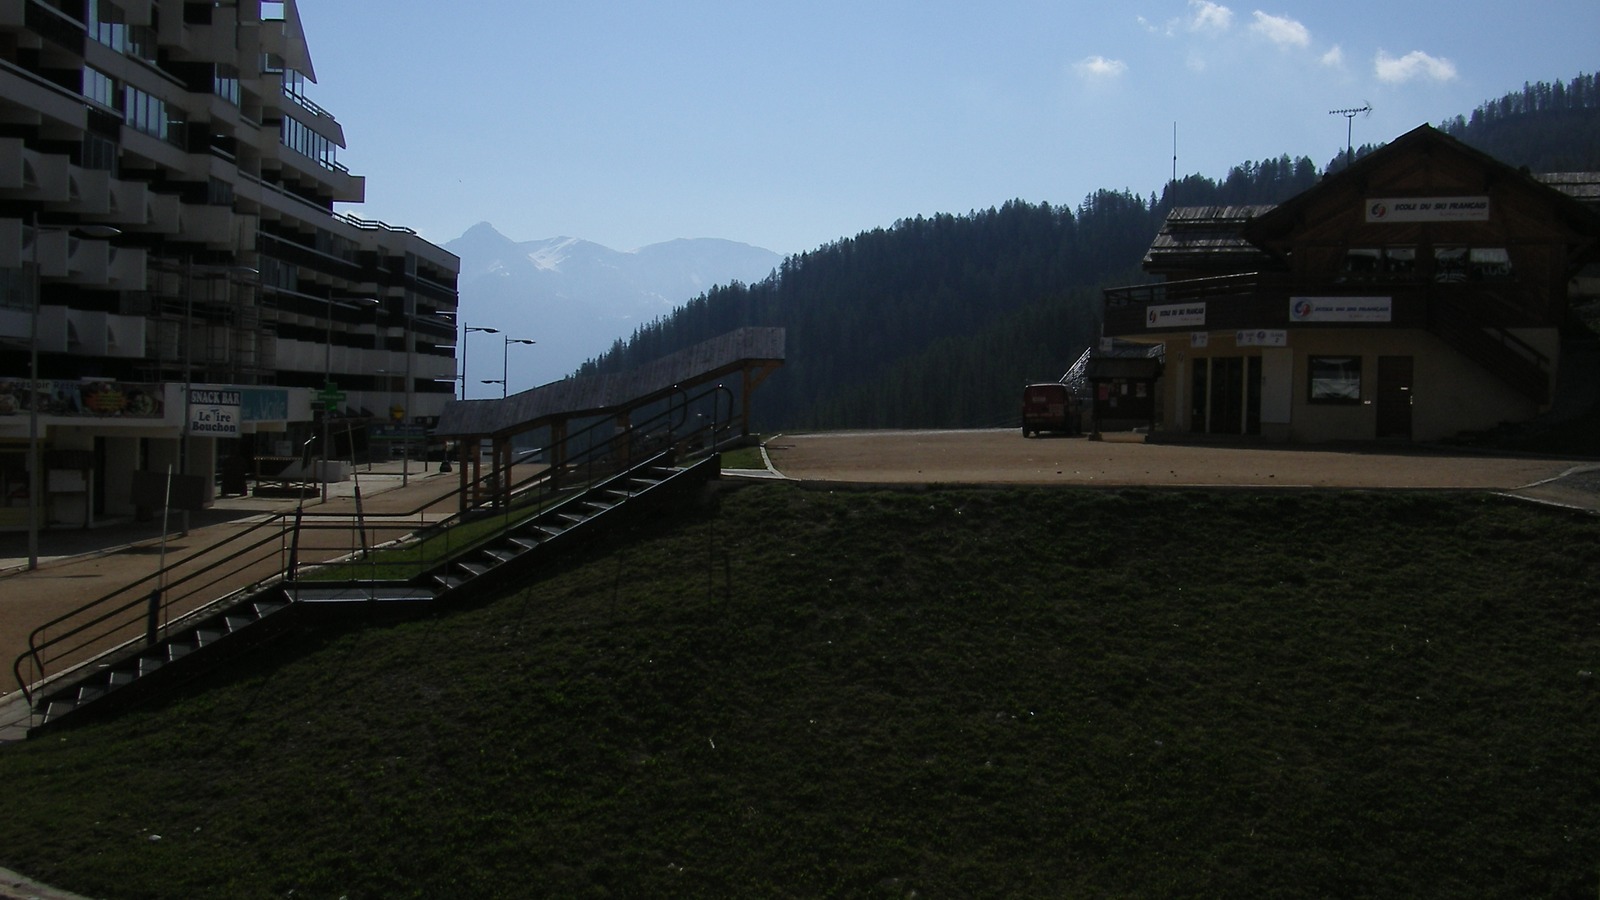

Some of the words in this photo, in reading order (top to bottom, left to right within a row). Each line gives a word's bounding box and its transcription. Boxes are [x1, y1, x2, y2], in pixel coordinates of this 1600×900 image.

[1433, 202, 1447, 210] SKI
[191, 391, 220, 404] SNACK
[221, 392, 240, 405] BAR
[198, 411, 211, 422] Le
[210, 409, 231, 423] Tire
[192, 421, 236, 433] Bouchon
